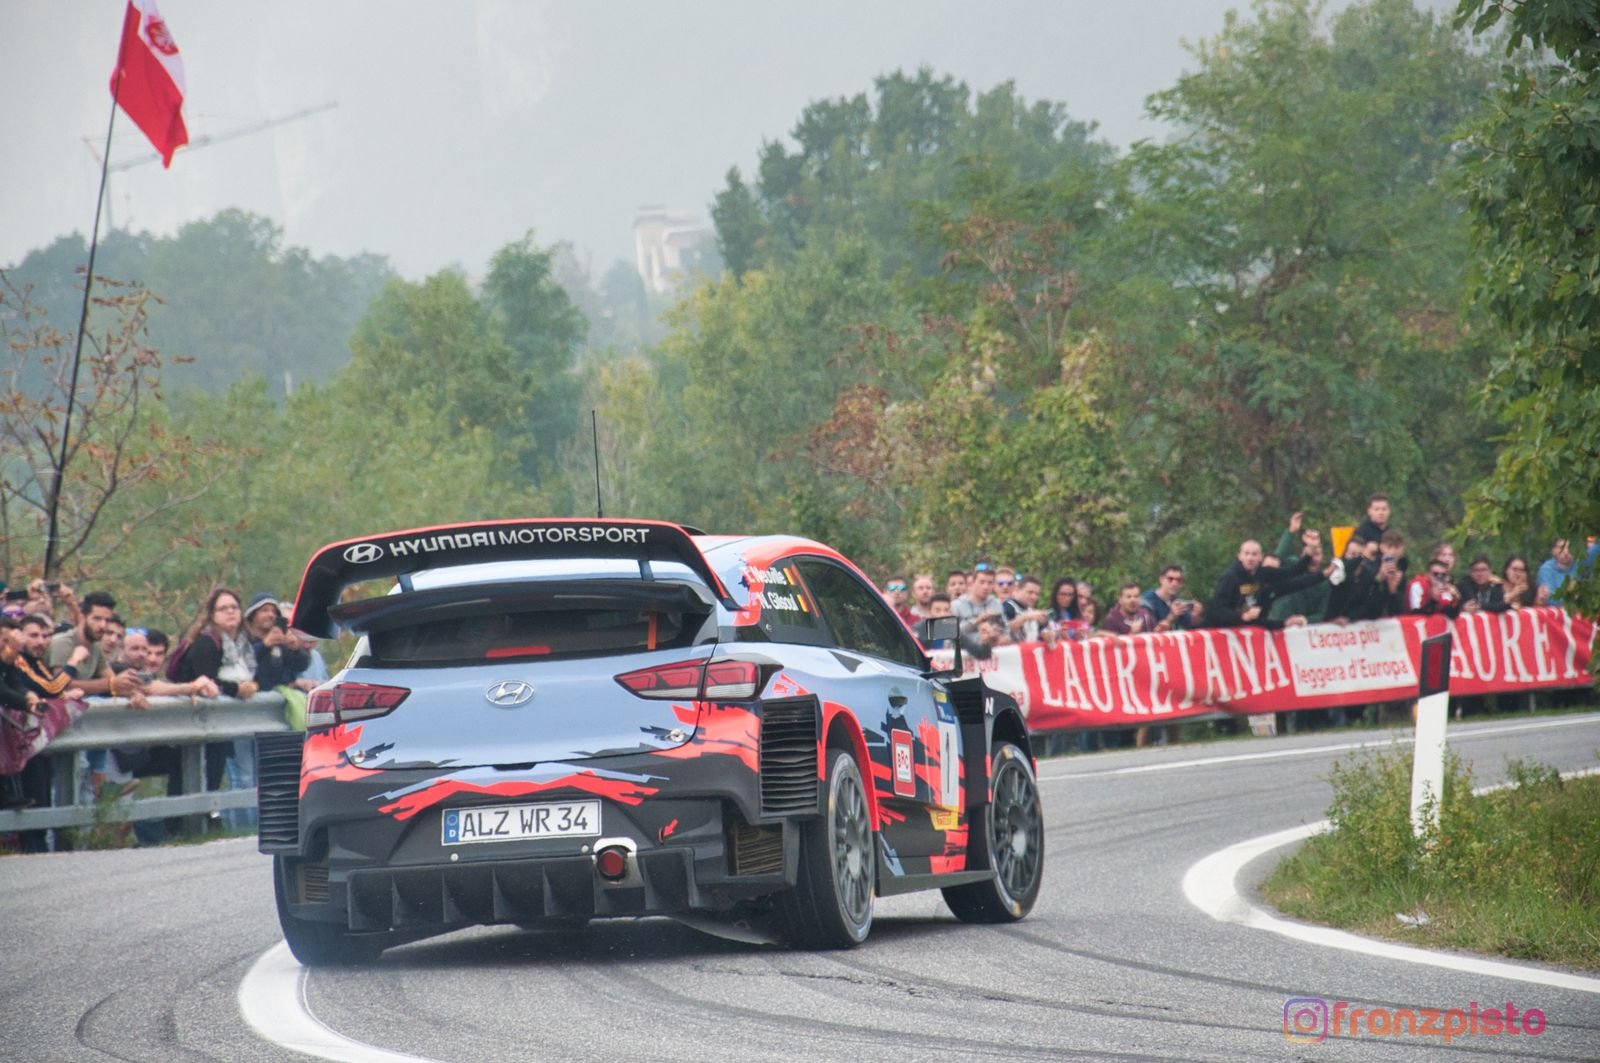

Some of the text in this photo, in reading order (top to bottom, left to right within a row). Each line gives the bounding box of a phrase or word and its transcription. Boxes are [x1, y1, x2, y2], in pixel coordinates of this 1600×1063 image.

[389, 527, 650, 557] HYUNDAI MOTORSPORT
[749, 566, 787, 585] Neuville
[1308, 624, 1380, 652] L'acqua più
[1032, 628, 1291, 715] LAURETANA
[1295, 658, 1408, 688] leggera d'Europa
[985, 697, 994, 716] N
[449, 829, 456, 838] D
[462, 805, 588, 838] ALZ WR 34
